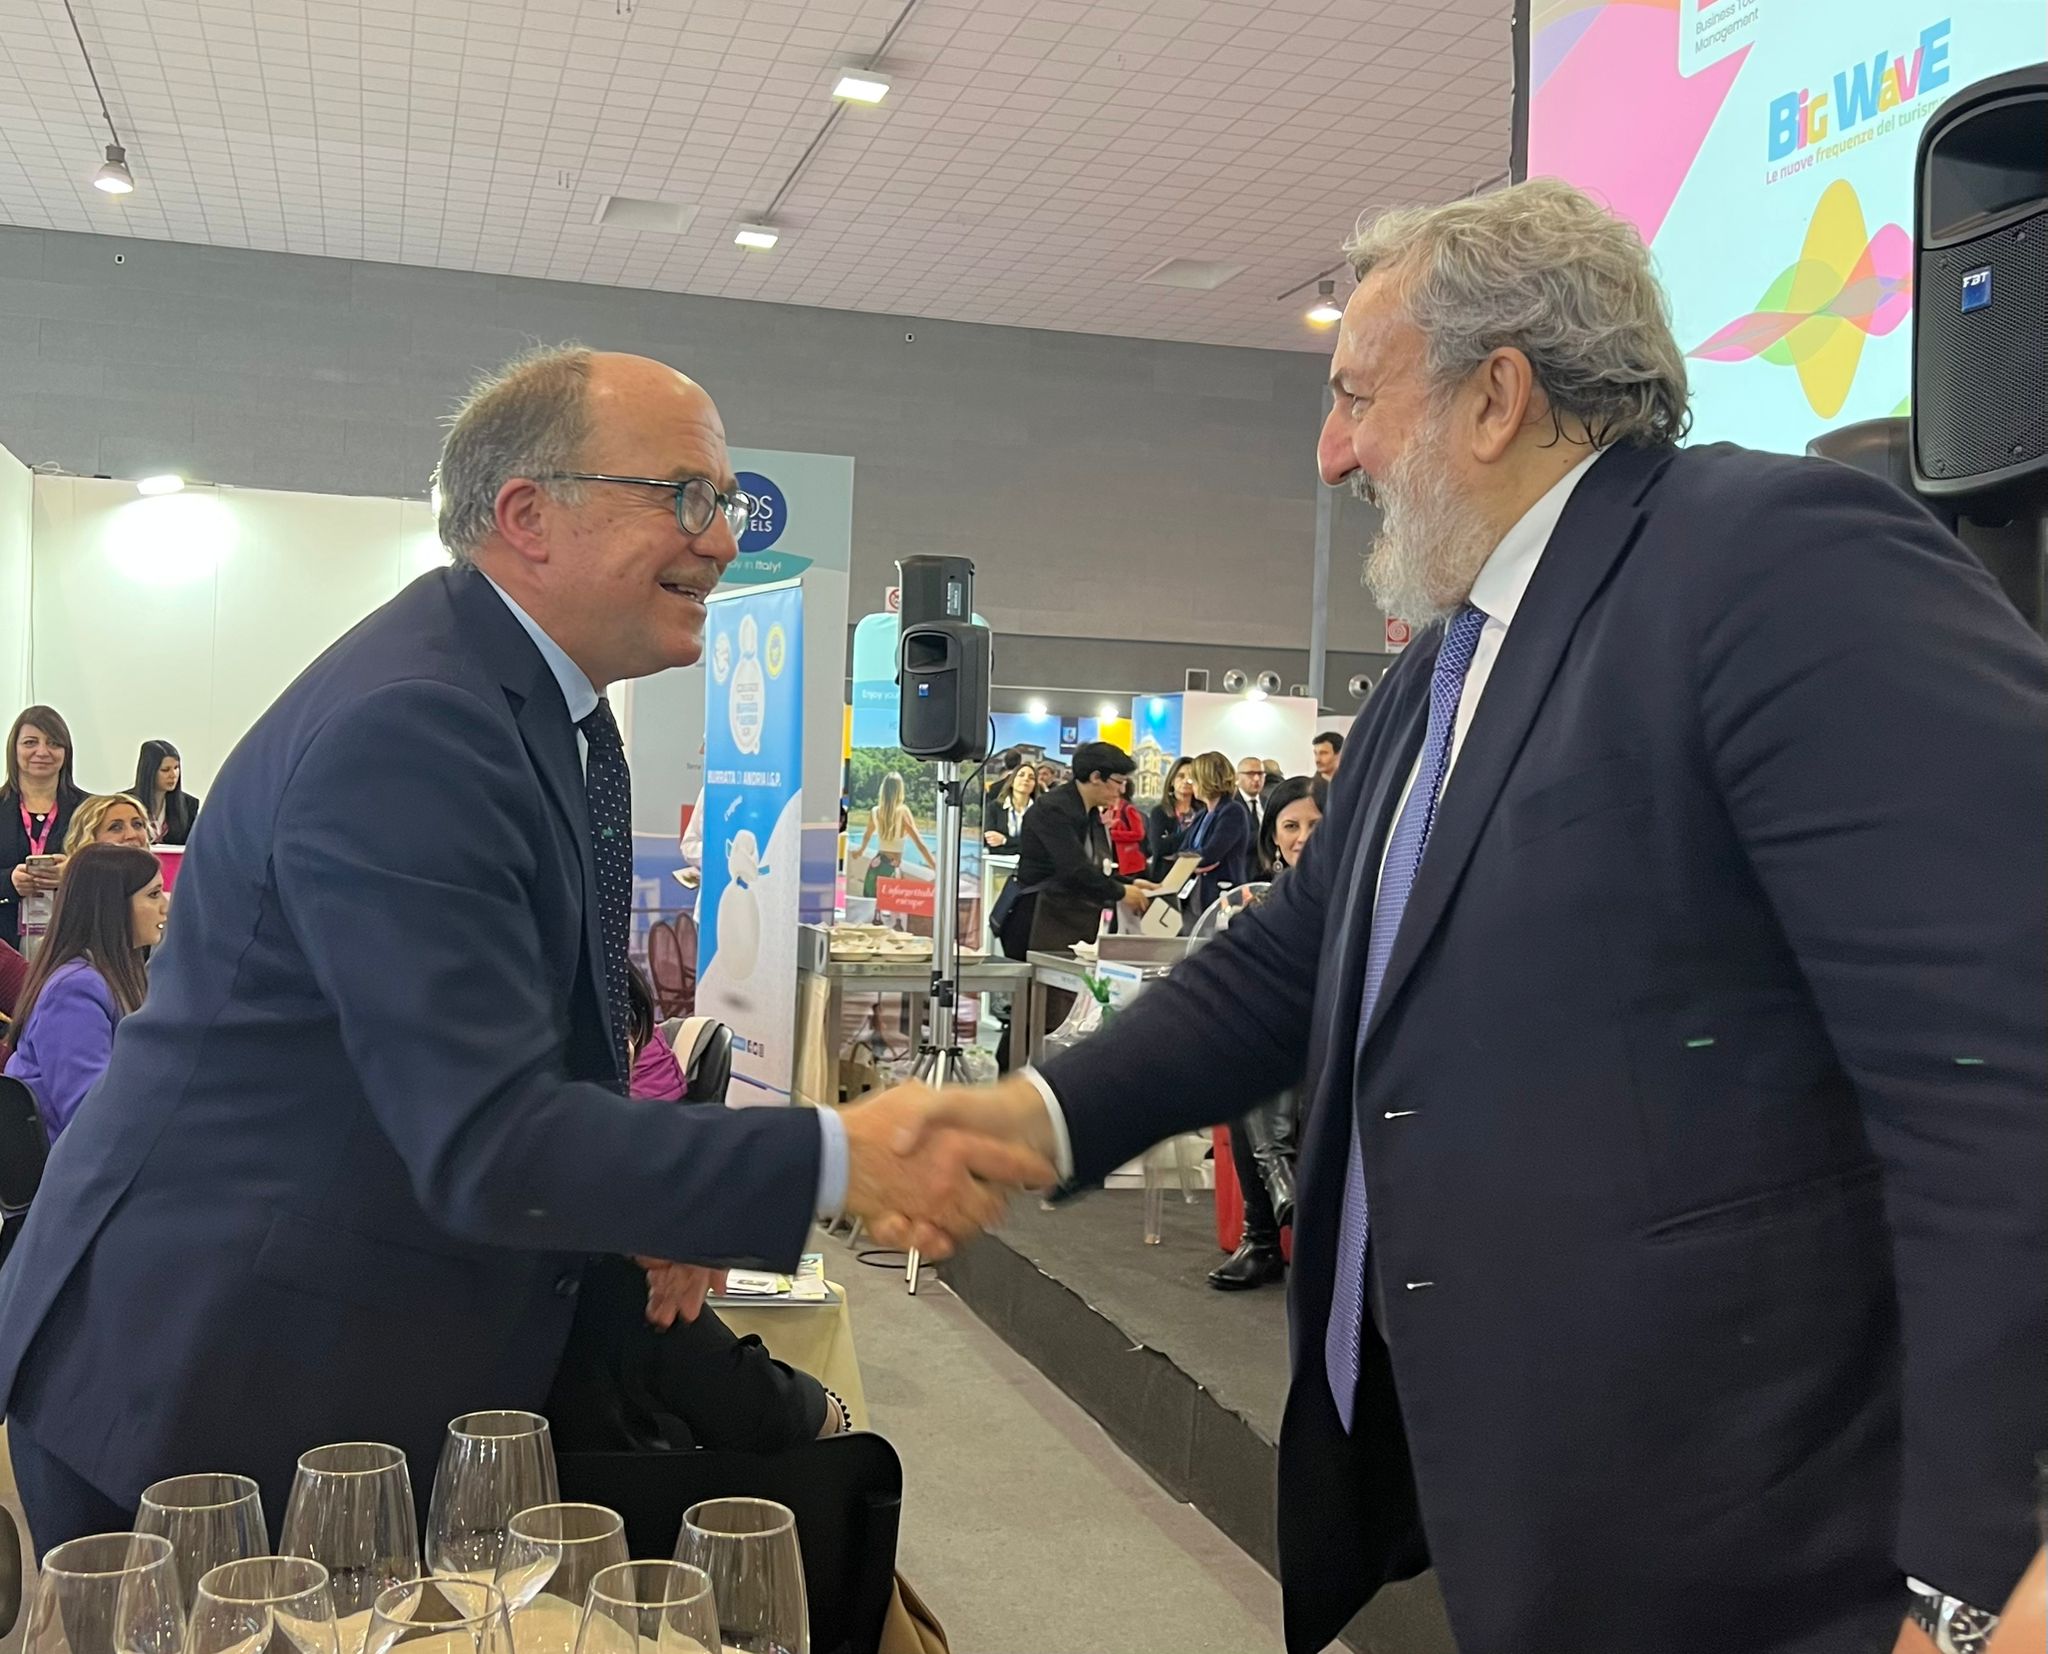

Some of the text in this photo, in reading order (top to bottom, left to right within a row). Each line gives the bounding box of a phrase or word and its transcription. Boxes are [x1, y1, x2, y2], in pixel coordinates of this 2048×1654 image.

[1695, 8, 1758, 54] Management
[1696, 4, 1735, 35] Business
[1766, 96, 1946, 185] Le nuove frequenze del turism
[1963, 270, 1990, 288] FBT
